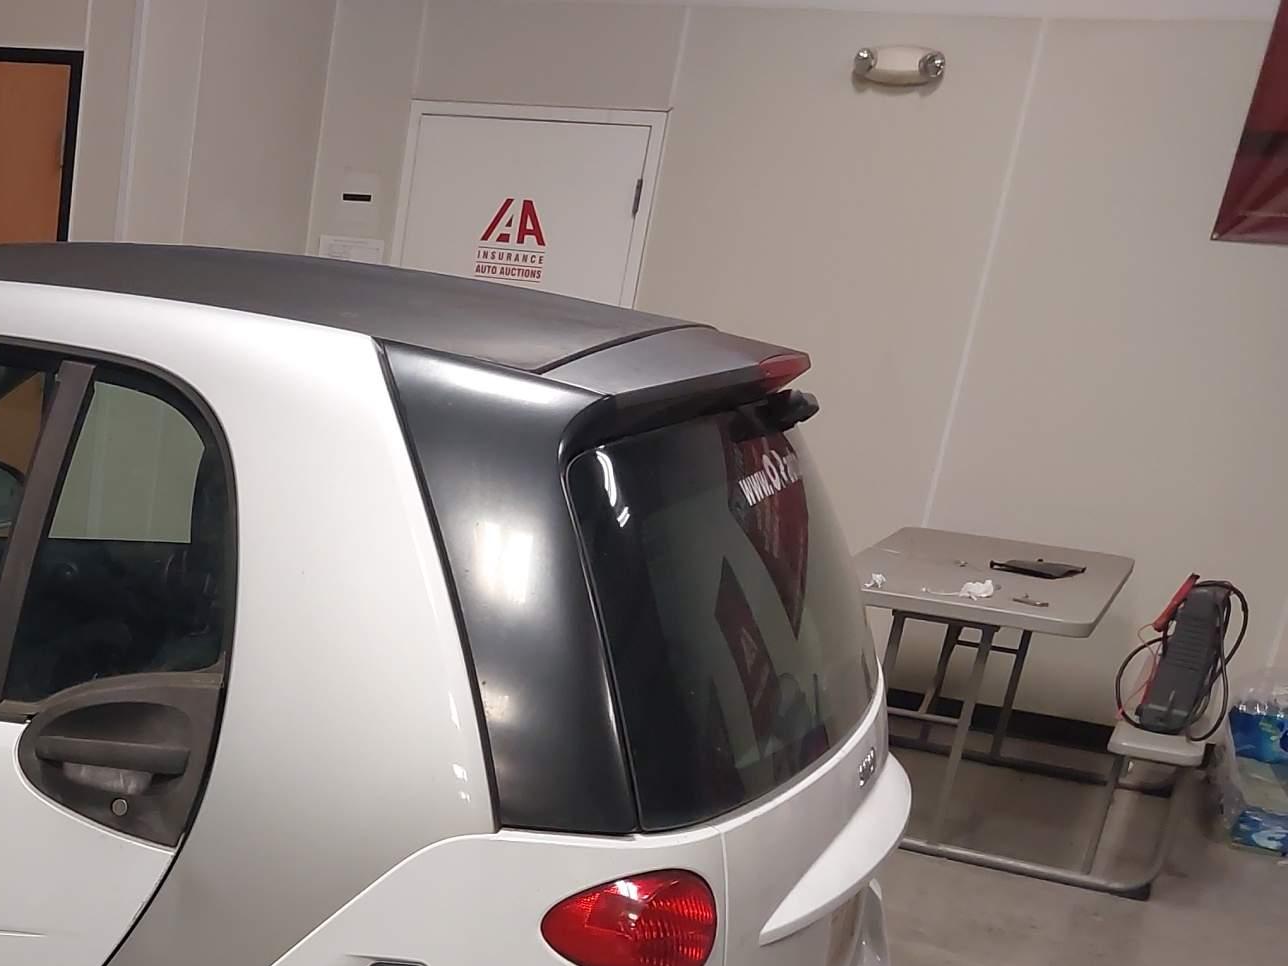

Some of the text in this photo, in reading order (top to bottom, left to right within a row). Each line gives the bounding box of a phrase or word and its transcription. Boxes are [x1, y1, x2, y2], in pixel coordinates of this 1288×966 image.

[477, 250, 544, 265] INSURANCE
[475, 264, 542, 279] AUTO AUCTIONS
